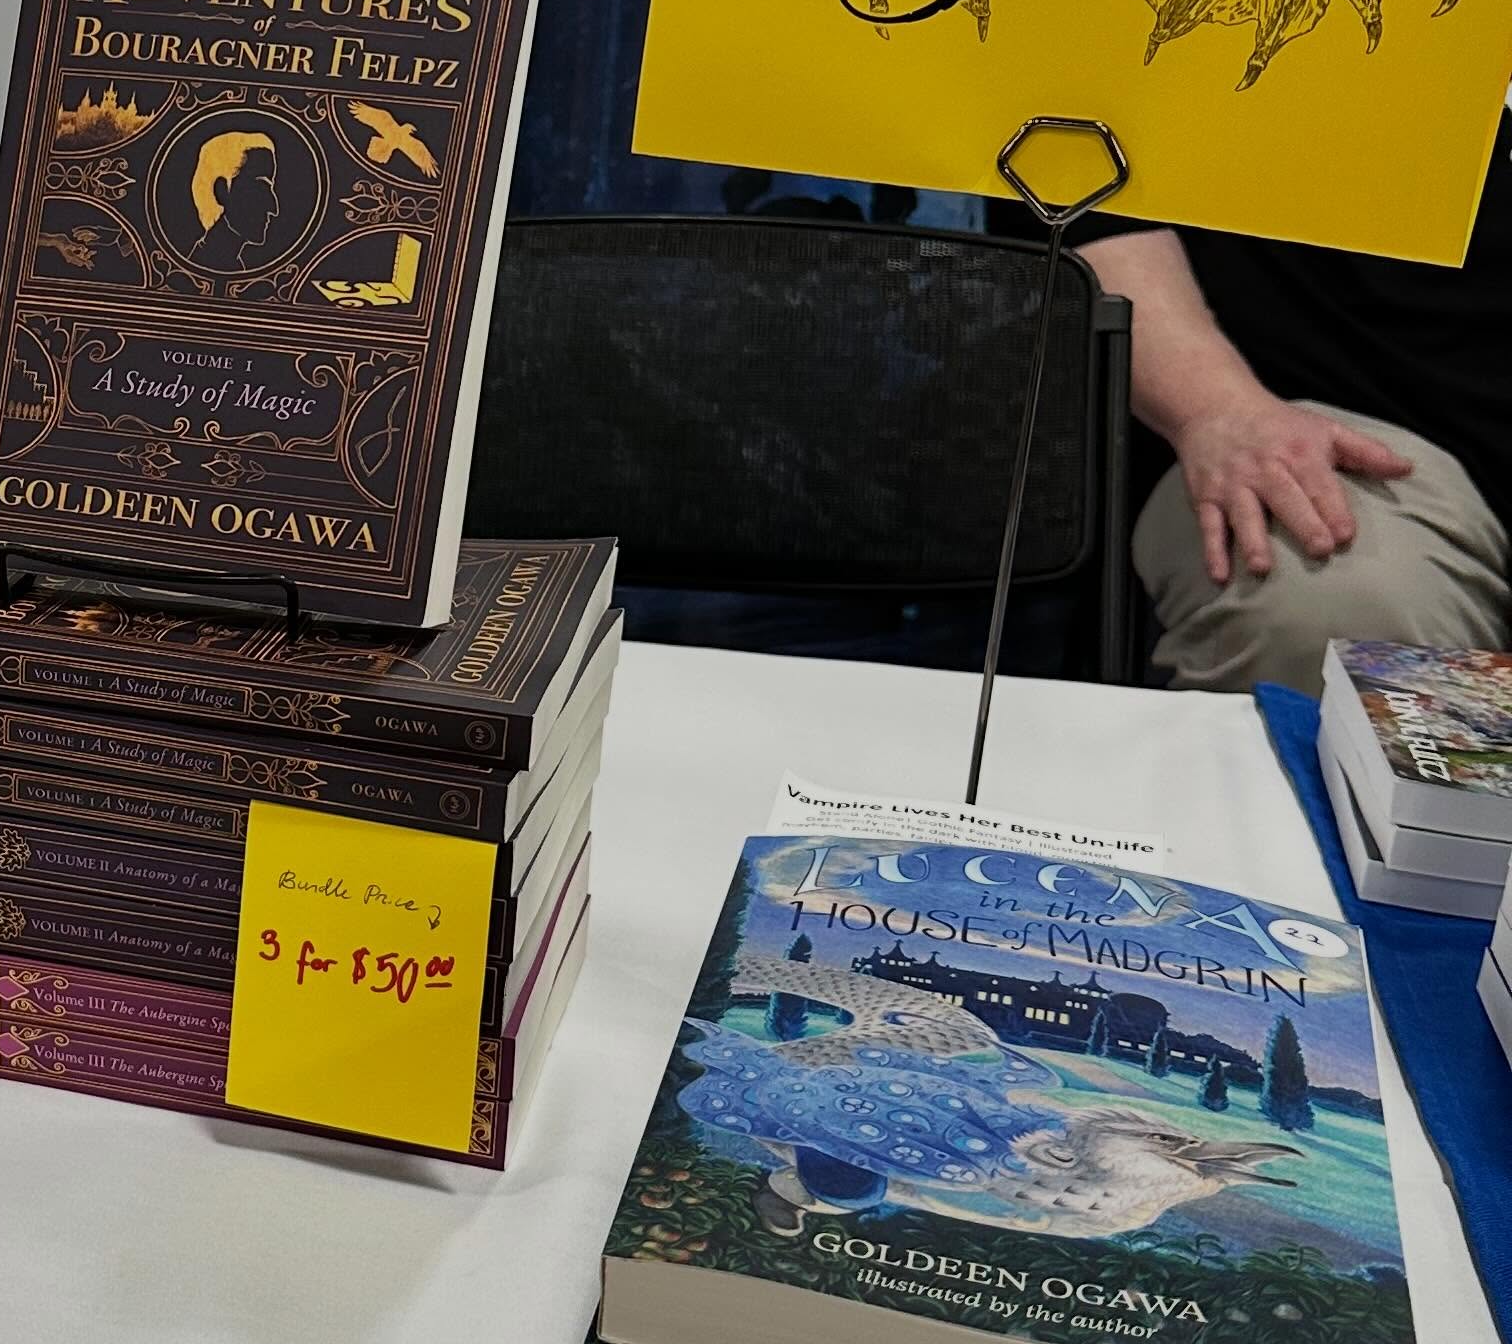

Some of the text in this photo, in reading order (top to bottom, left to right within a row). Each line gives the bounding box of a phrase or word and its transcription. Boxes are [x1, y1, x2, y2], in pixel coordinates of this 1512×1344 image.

[253, 12, 276, 37] of
[71, 16, 461, 90] BOURAGNER FELPZ
[161, 350, 234, 371] VOLUME
[91, 367, 317, 419] A Study of Magic
[210, 502, 378, 555] OGAWA
[450, 552, 551, 685] GOLDEEN OGAWA
[33, 667, 90, 686] VOLUME
[108, 678, 122, 690] A
[125, 678, 167, 699] Study
[171, 684, 189, 704] of
[191, 687, 236, 709] Magic
[375, 715, 439, 737] OGAWA
[787, 783, 884, 812] Vampire
[892, 803, 951, 820] Lives
[959, 813, 1002, 830] Her
[1011, 823, 1063, 843] Best
[1070, 835, 1156, 855] Un-life
[36, 850, 97, 870] VOLUME
[113, 861, 178, 886] Anatomy
[182, 872, 199, 888] of
[200, 878, 209, 888] a
[277, 869, 420, 912] Bundle Price
[791, 844, 1305, 974] LUCENA
[978, 889, 1117, 929] in the
[258, 928, 281, 961] 3
[296, 940, 339, 986] for
[790, 900, 1308, 1010] HOUSE of MADGRIN
[33, 987, 86, 1007] Volume
[88, 996, 105, 1011] III
[110, 999, 136, 1017] The
[137, 1005, 208, 1028] Aubergine
[812, 1232, 1210, 1323] GOLDEEN OGAWA
[856, 1267, 1161, 1340] illustrated by the author
